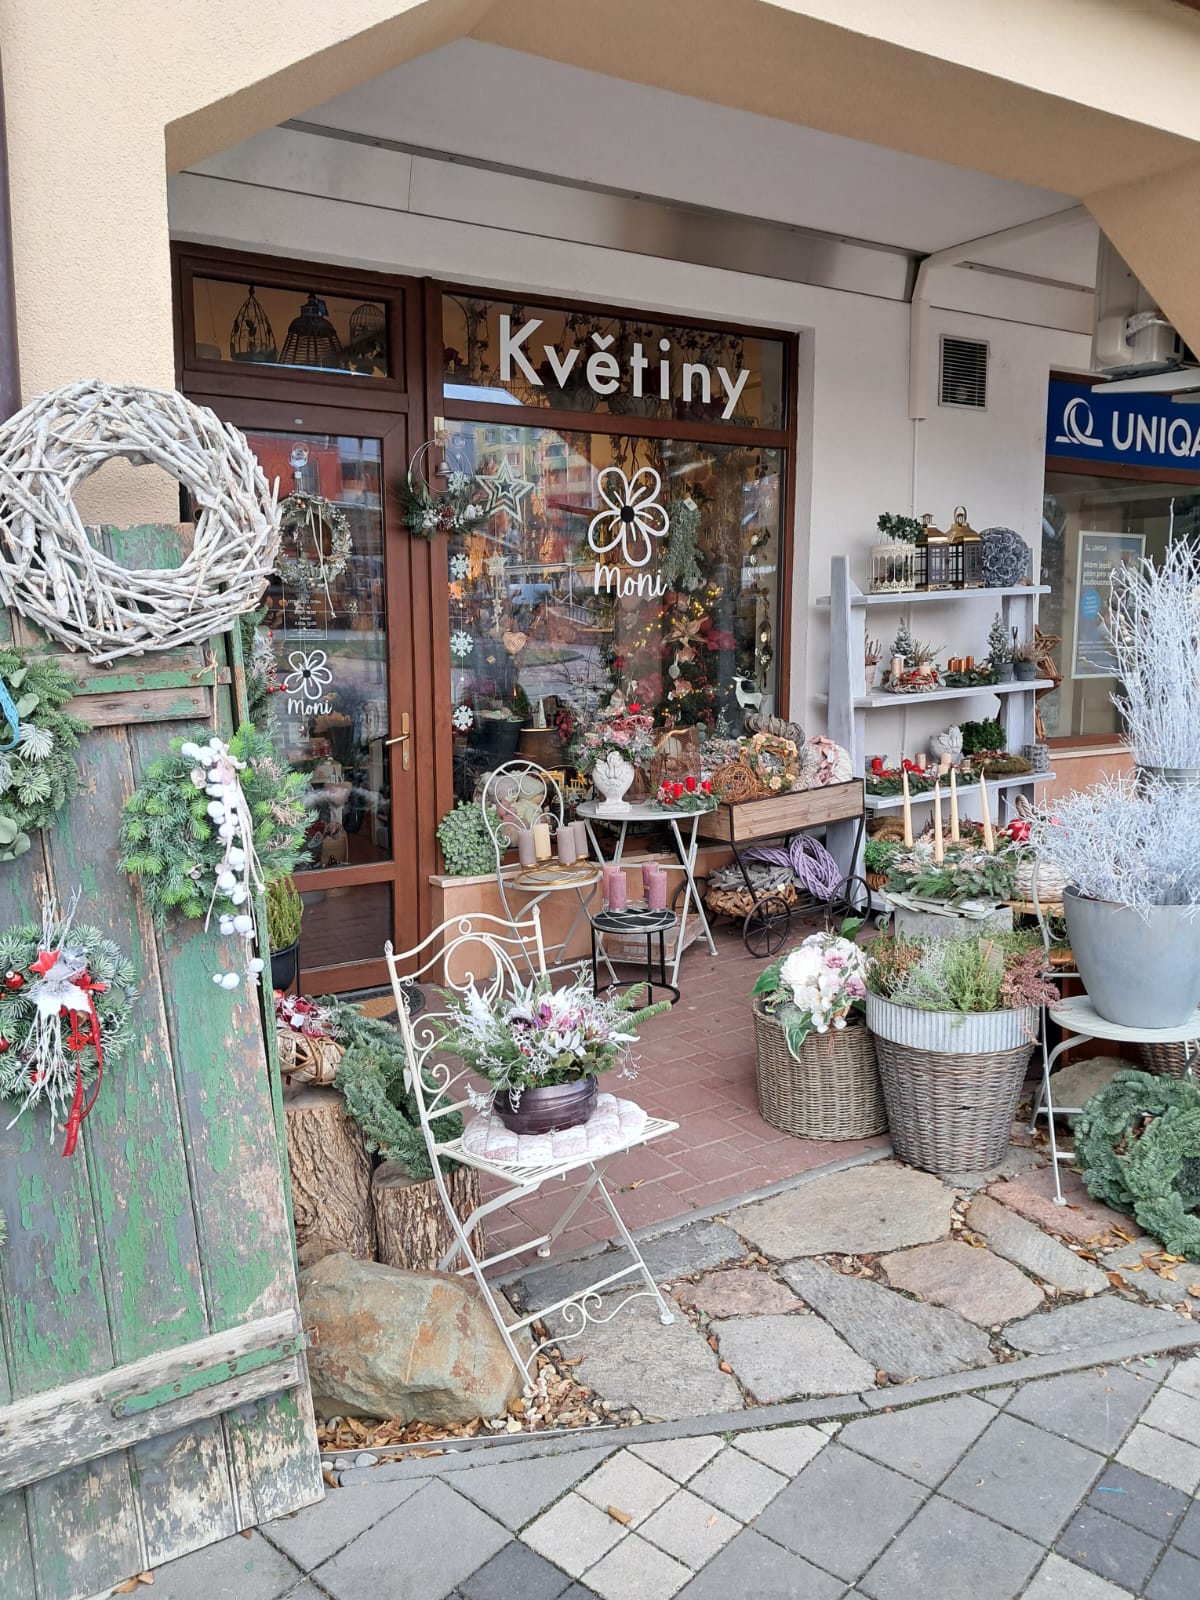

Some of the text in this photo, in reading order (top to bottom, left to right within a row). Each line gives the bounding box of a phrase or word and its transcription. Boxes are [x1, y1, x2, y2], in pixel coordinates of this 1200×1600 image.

[499, 313, 751, 420] Květiny
[593, 561, 667, 599] Moni
[287, 697, 333, 716] Moni
